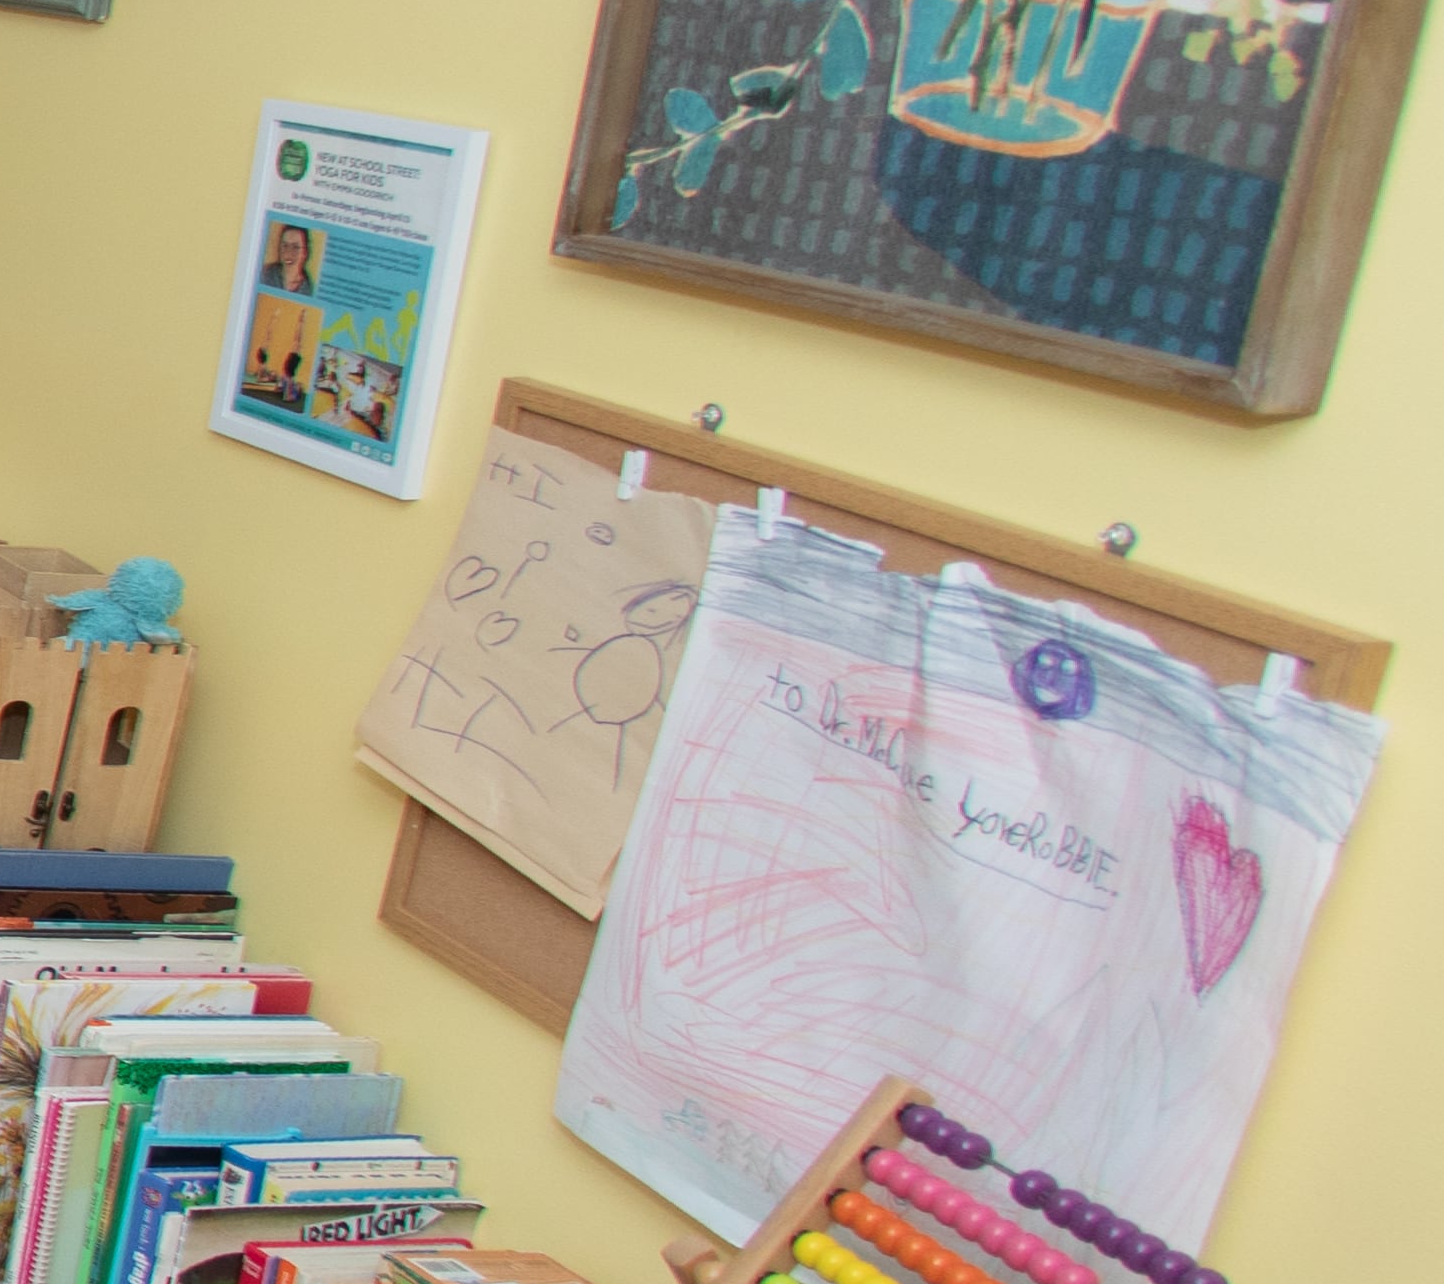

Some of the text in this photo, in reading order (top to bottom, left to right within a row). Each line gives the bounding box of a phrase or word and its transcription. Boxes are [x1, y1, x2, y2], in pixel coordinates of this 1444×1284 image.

[315, 164, 385, 188] YOGA FOR KIDS
[338, 155, 349, 165] AT
[350, 157, 385, 174] SCHOOL
[766, 662, 804, 713] to
